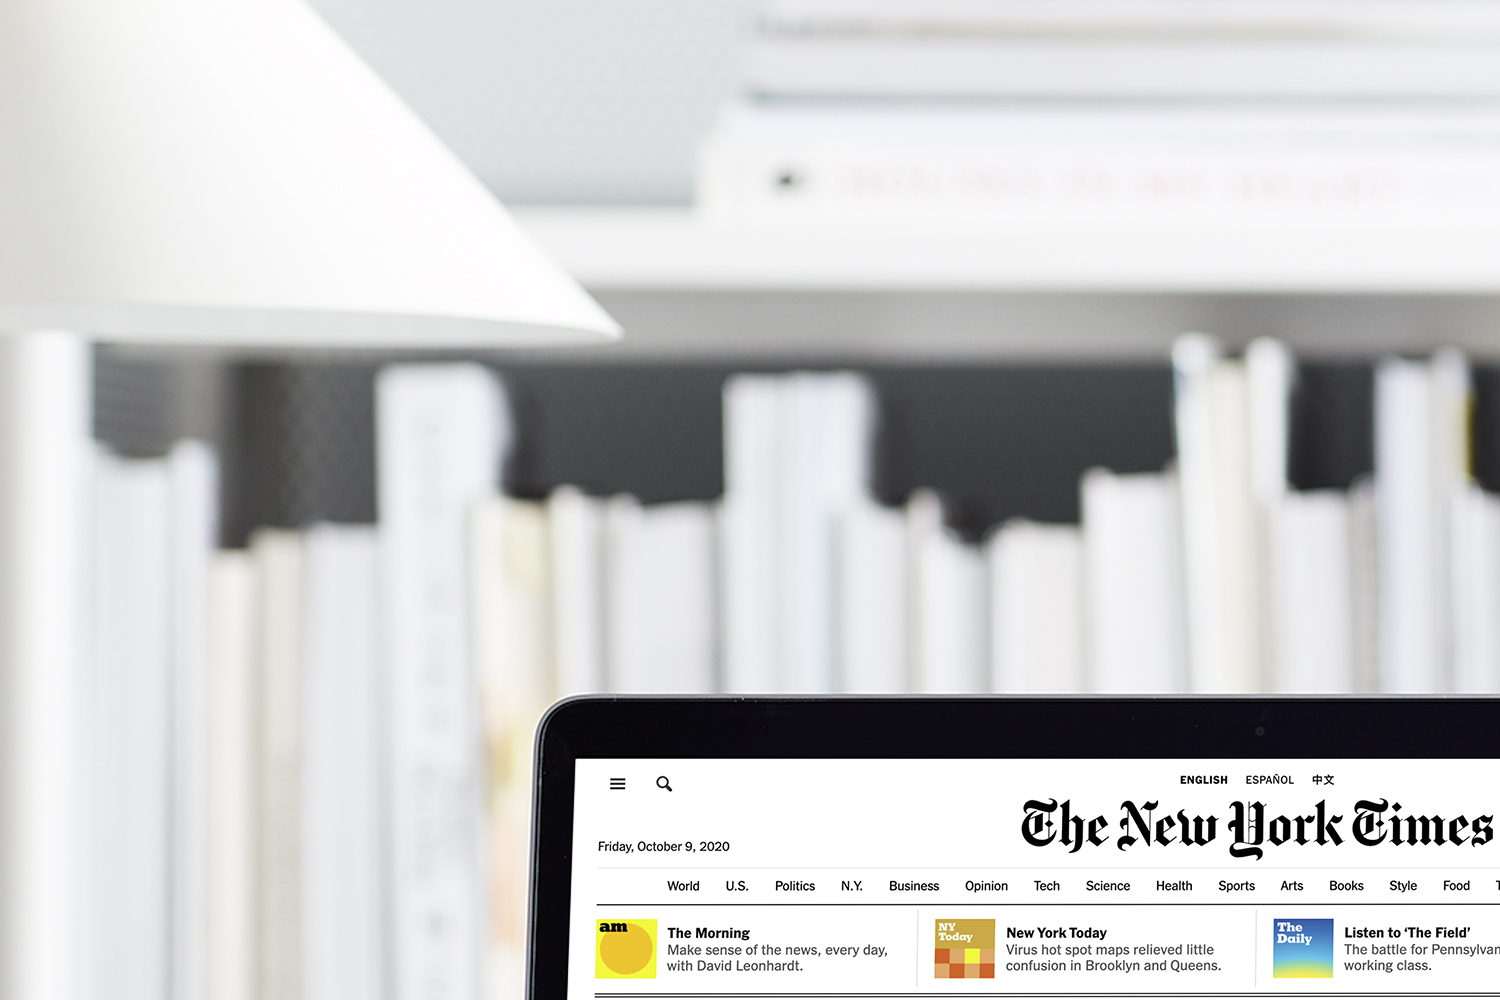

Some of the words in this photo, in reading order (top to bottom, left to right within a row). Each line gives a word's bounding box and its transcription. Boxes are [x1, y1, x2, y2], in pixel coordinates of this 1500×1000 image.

[1180, 775, 1228, 784] ENGLISH
[1246, 774, 1294, 784] ESPAÑOL
[1312, 774, 1334, 785] 中文
[1021, 798, 1109, 853] The
[1117, 800, 1219, 851] New
[1228, 799, 1344, 861] York
[1352, 798, 1493, 847] Times
[598, 841, 634, 854] Friday,
[637, 841, 683, 852] October
[685, 841, 696, 853] 9,
[700, 841, 730, 852] 2020
[667, 881, 700, 891] World
[726, 880, 749, 891] U.S.
[775, 880, 816, 891] Politics
[841, 880, 863, 891] N.Y.
[889, 880, 940, 891] Business
[965, 880, 1008, 893] Opinion
[1034, 880, 1060, 891] Tech
[1086, 880, 1130, 891] Science
[1156, 880, 1193, 891] Health
[1218, 880, 1255, 893] Sports
[1280, 880, 1304, 891] Arts
[1330, 880, 1364, 891] Books
[1389, 880, 1417, 893] Style
[1443, 880, 1470, 891] Food
[600, 923, 627, 932] am
[938, 923, 959, 932] NY
[1277, 922, 1303, 932] The
[667, 927, 692, 939] The
[696, 927, 750, 941] Morning
[938, 932, 973, 943] Today
[1007, 927, 1035, 938] New
[1037, 927, 1067, 938] York
[1069, 927, 1107, 941] Today
[1277, 934, 1312, 945] Daily
[1006, 944, 1038, 955] Virus
[1042, 944, 1061, 955] hot
[1065, 944, 1092, 957] spot
[1096, 946, 1130, 957] maps
[1134, 944, 1182, 955] relieved
[1187, 944, 1214, 955] little
